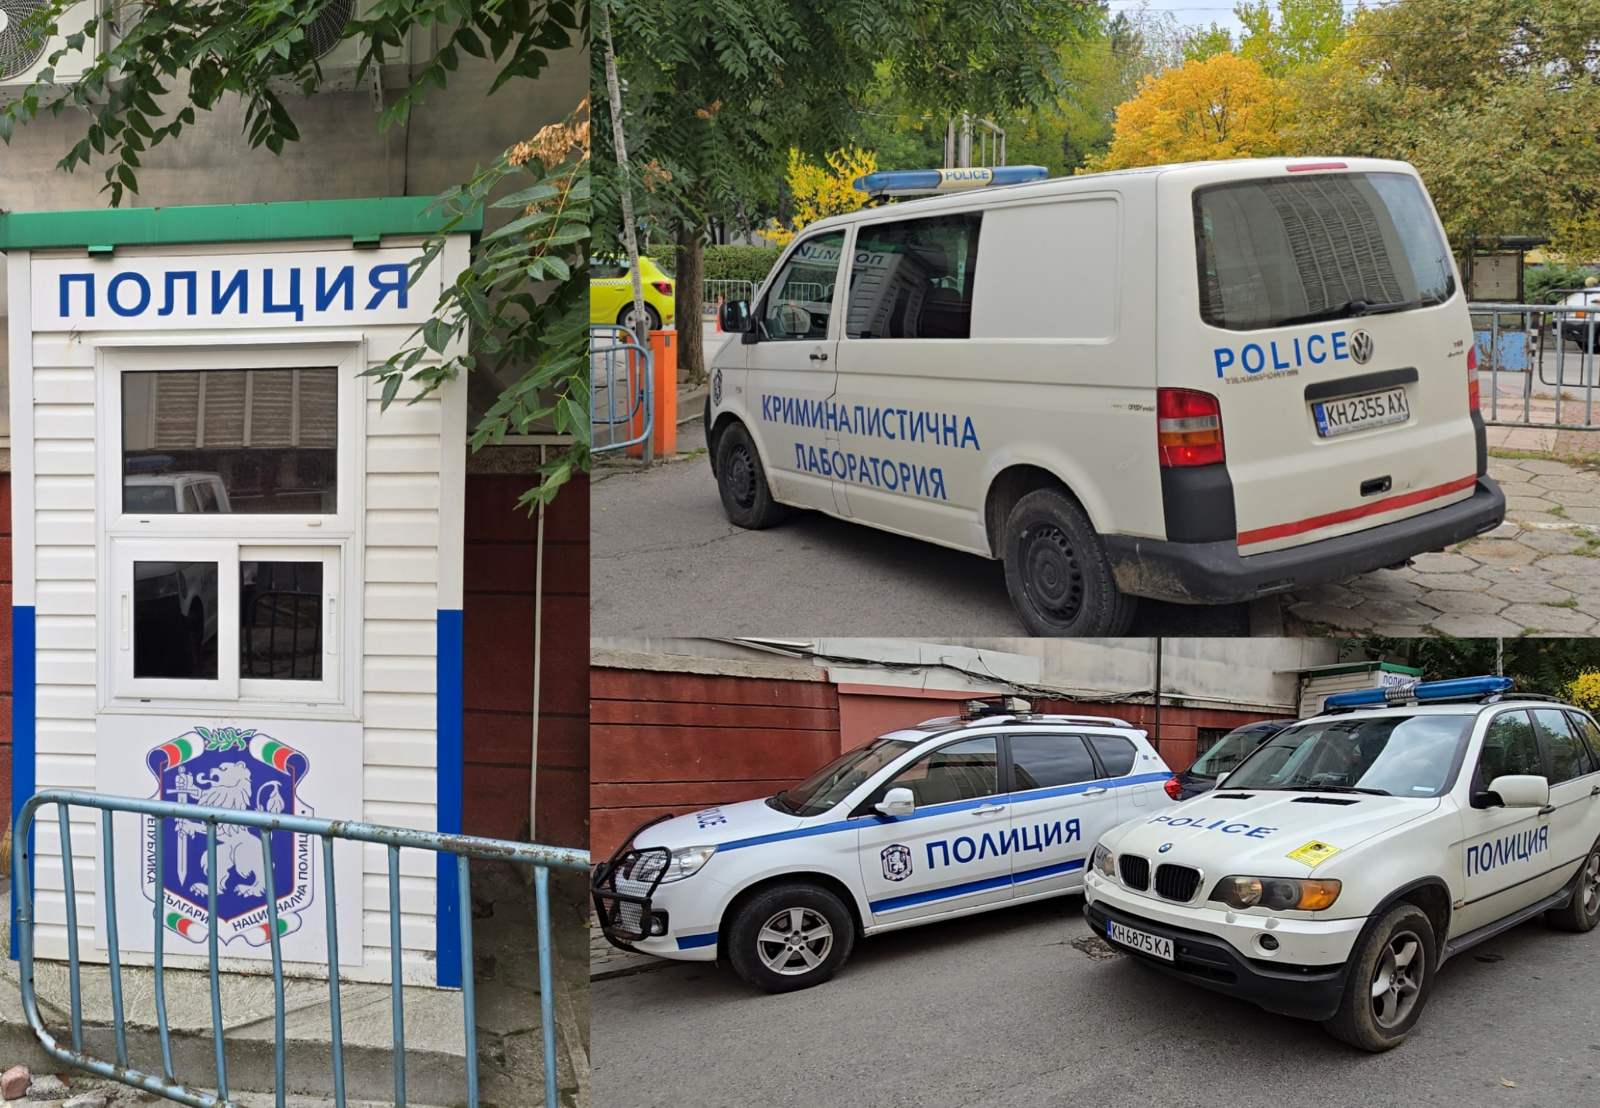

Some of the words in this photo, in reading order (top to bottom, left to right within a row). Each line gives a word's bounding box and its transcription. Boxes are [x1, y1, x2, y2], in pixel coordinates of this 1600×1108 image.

[944, 169, 990, 181] POLICE
[59, 264, 409, 321] ПОЛИЦИЯ
[1214, 331, 1349, 378] POLICE
[761, 394, 980, 450] КРИМИНАЛИСТИЧНА
[795, 443, 947, 500] ЛАБОРАТОРИЯ
[926, 817, 1082, 870] ПОЛИЦИЯ
[1148, 816, 1279, 839] POLICE
[1467, 825, 1549, 877] ПОЛИЦИЯ
[298, 833, 309, 881] ПОЛИЦ
[163, 893, 209, 925] ЪЛГАРИ
